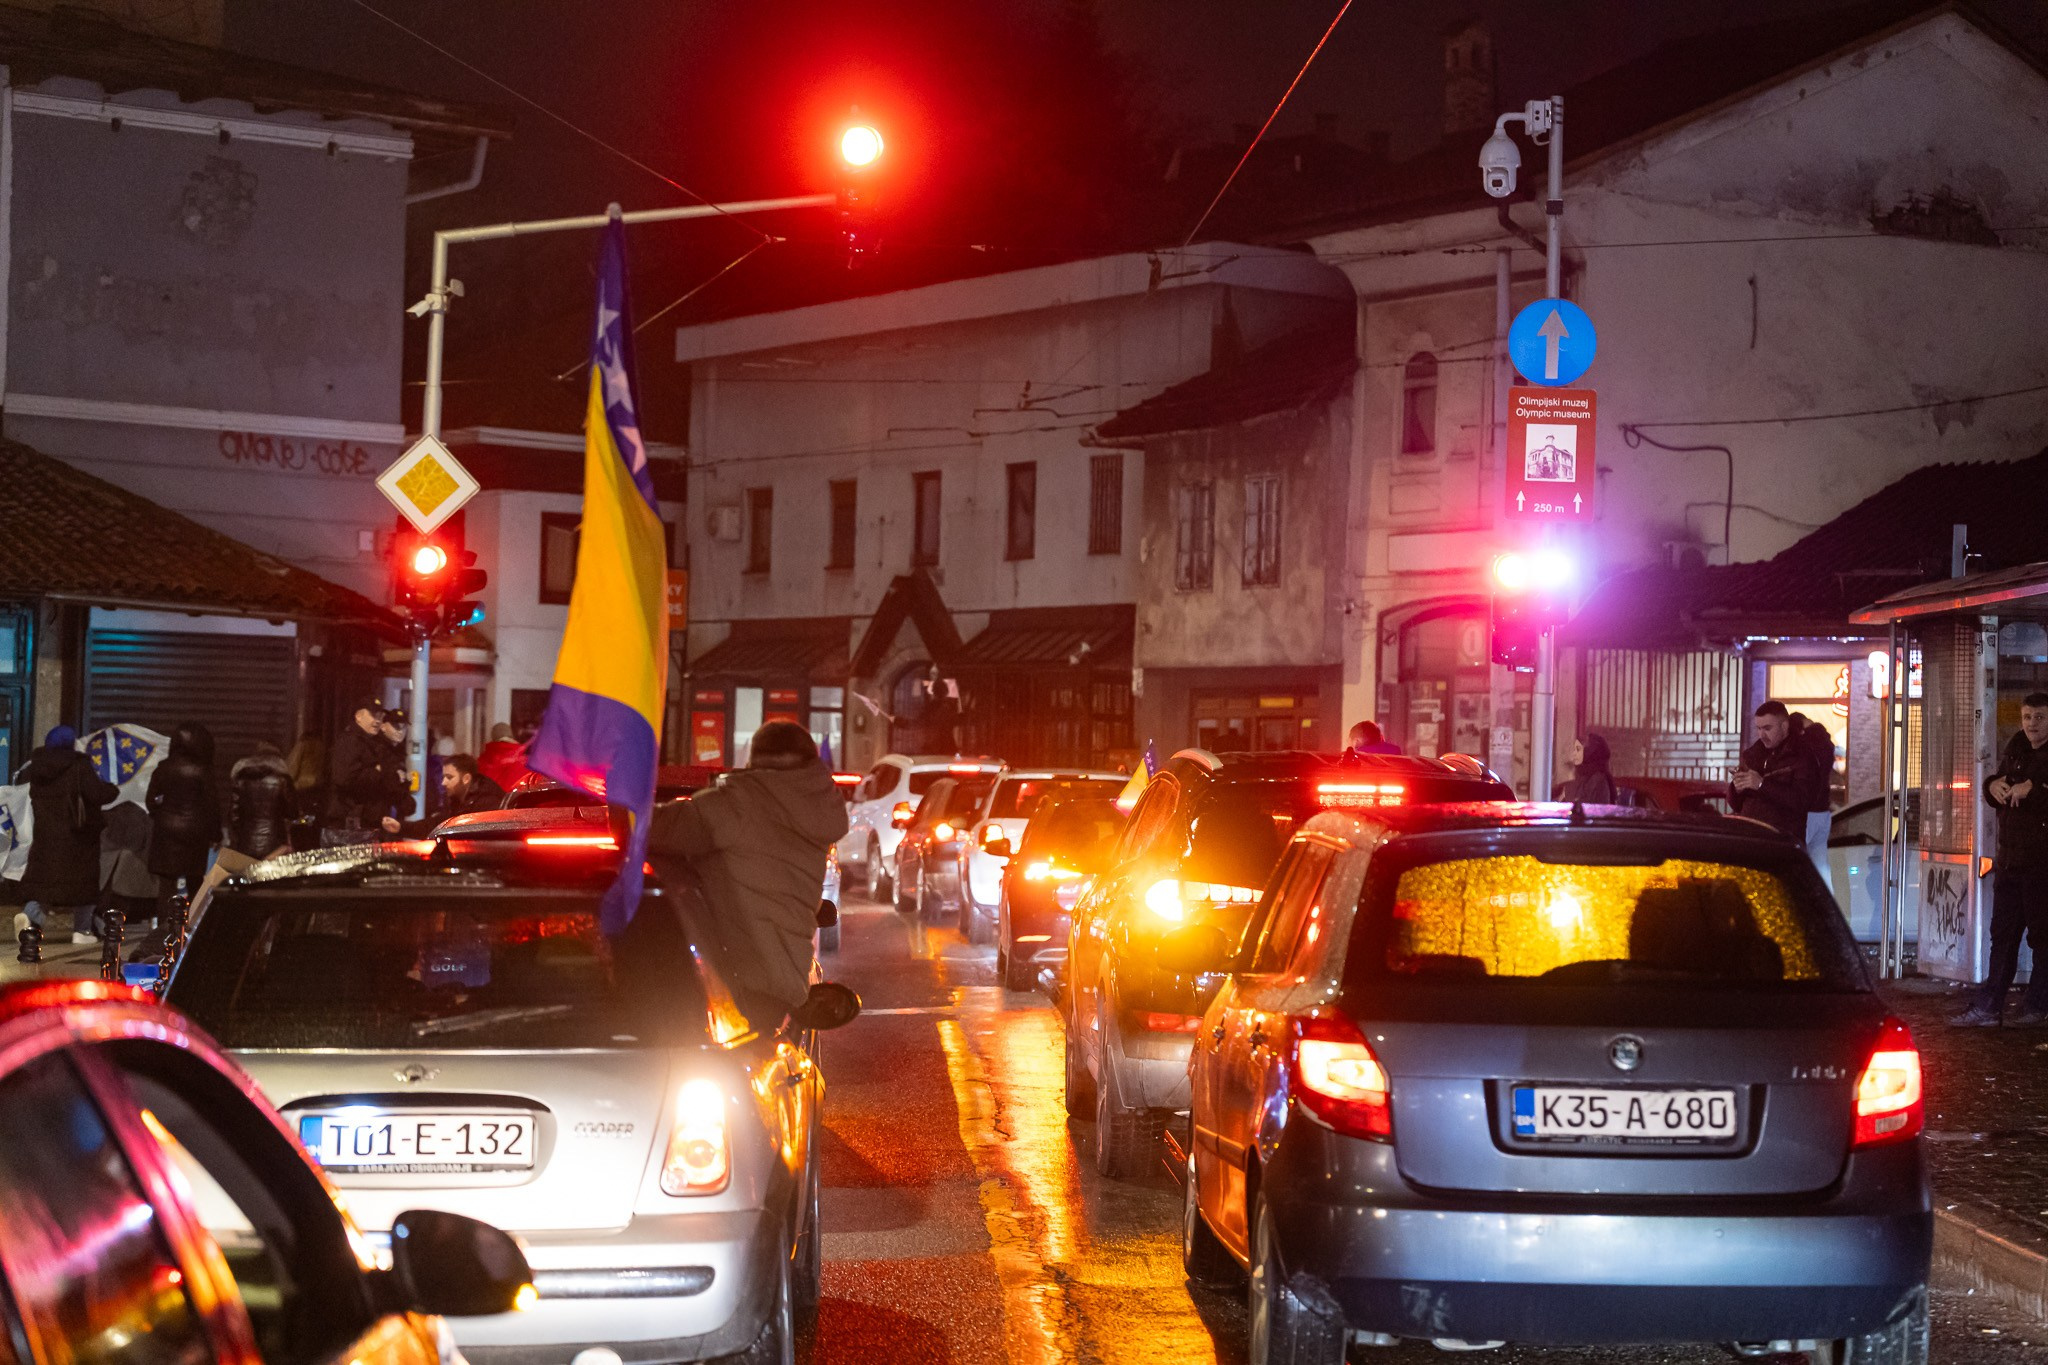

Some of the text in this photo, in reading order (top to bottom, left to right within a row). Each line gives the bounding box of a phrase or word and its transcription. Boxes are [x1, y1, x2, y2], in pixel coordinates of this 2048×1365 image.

[1518, 397, 1589, 408] Olimpijski muzej
[1516, 408, 1590, 419] Olympic museum
[1534, 503, 1564, 513] 250 m
[1542, 1095, 1728, 1130] K35-A-680
[329, 1123, 523, 1157] T01-E-132
